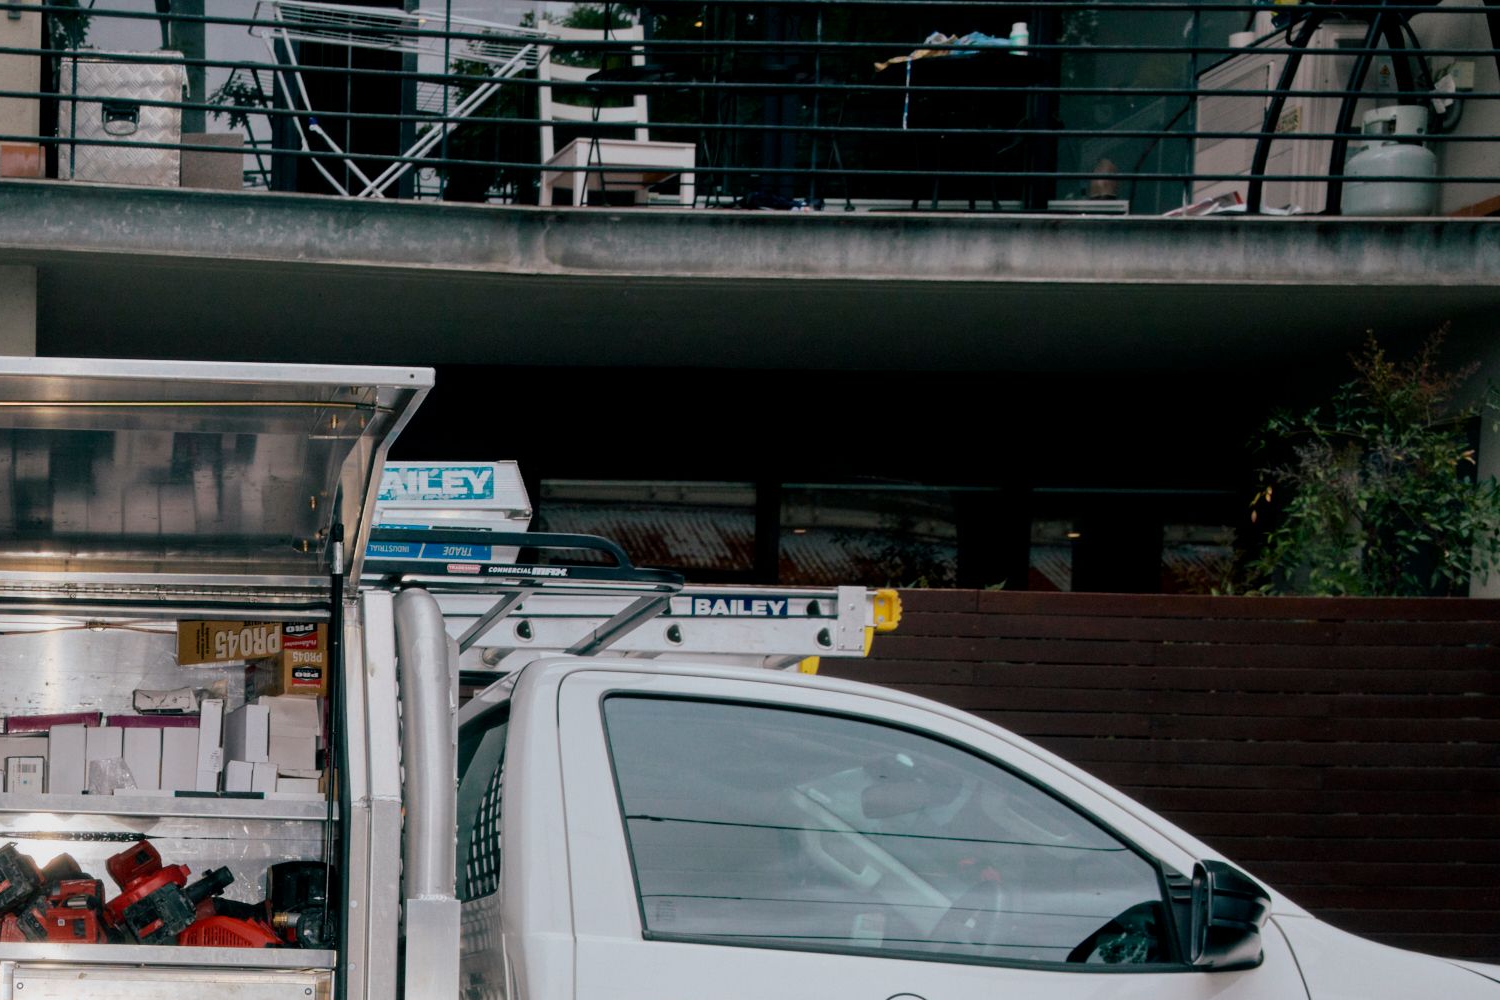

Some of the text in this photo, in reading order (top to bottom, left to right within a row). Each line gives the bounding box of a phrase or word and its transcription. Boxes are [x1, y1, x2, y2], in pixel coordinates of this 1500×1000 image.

[379, 470, 492, 496] AILEY
[370, 544, 472, 557] TRADE INDUSTRIAL
[488, 566, 531, 575] COMMERCIAL
[694, 597, 787, 617] BAILEY
[285, 624, 314, 633] PRO
[214, 625, 280, 659] PRO45
[292, 652, 322, 663] PRO45
